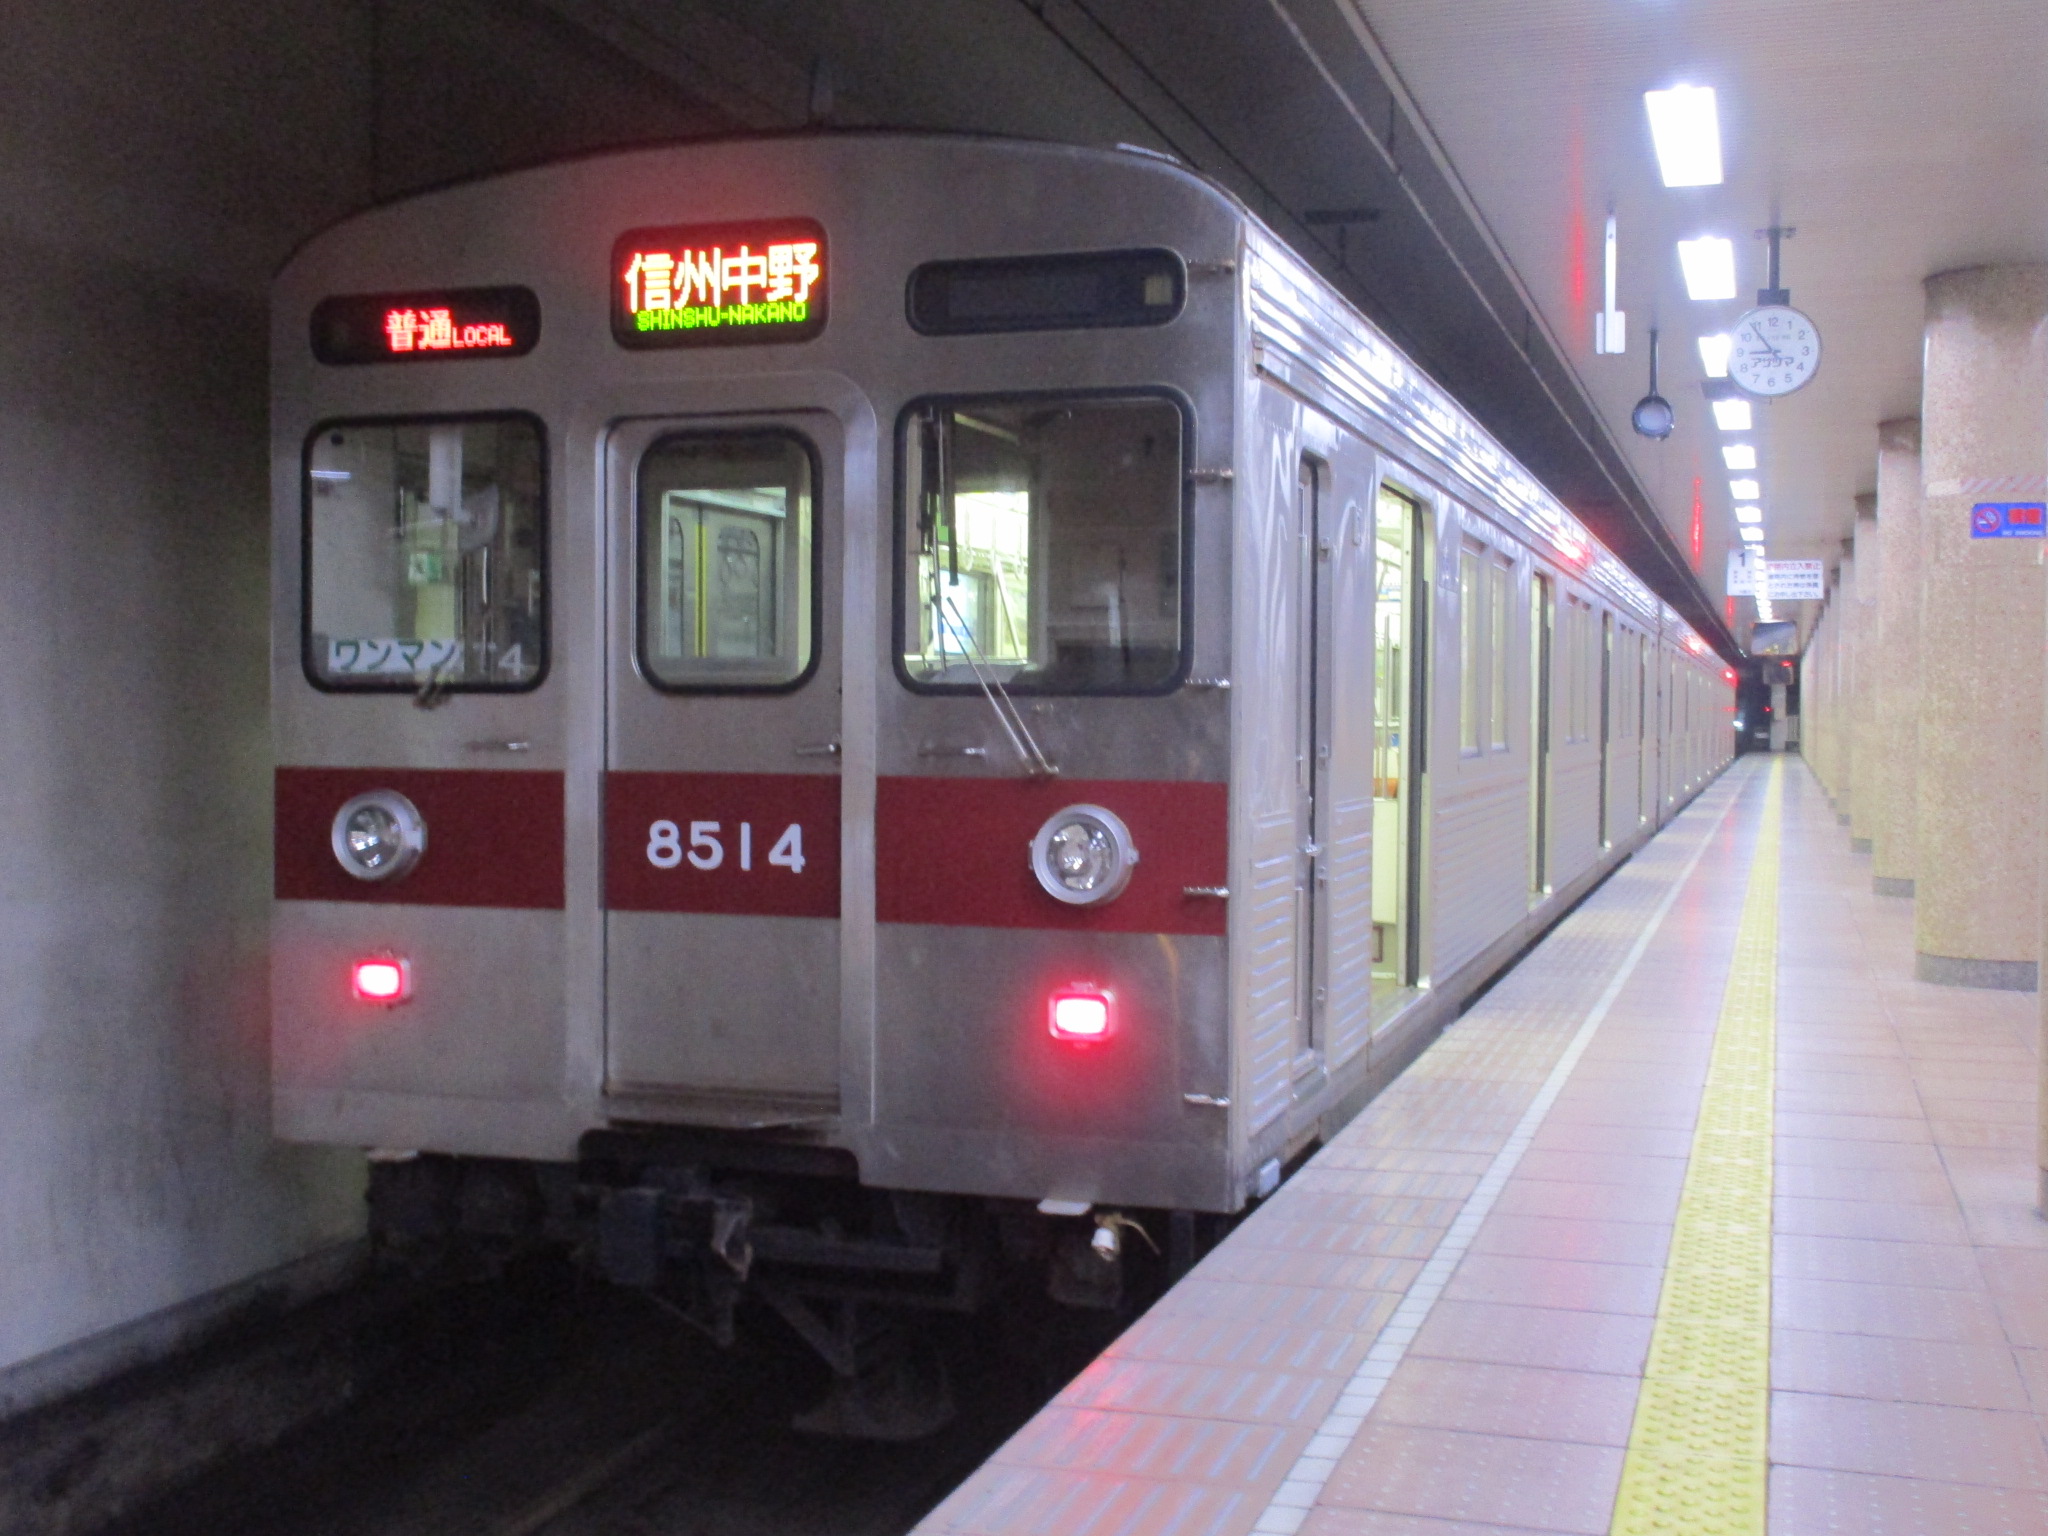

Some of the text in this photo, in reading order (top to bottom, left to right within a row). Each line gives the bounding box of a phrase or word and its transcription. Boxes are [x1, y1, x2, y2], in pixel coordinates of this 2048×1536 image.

[624, 241, 820, 314] 信州中野
[637, 301, 806, 331] SHINSHU-NAKANO
[1768, 317, 1779, 327] 12
[1787, 320, 1792, 330] 1
[385, 307, 452, 351] 普通
[452, 324, 512, 348] LOCAL
[1741, 333, 1751, 343] 10
[1798, 330, 1806, 340] 2
[1737, 347, 1744, 357] 9
[1802, 346, 1809, 356] 3
[1740, 363, 1748, 373] 8
[1797, 362, 1804, 372] 4
[1753, 374, 1760, 384] 7
[1768, 378, 1775, 388] 6
[1785, 374, 1792, 384] 5
[1739, 552, 1745, 567] 1
[335, 640, 456, 672] ワンマン
[646, 819, 806, 873] 8514
